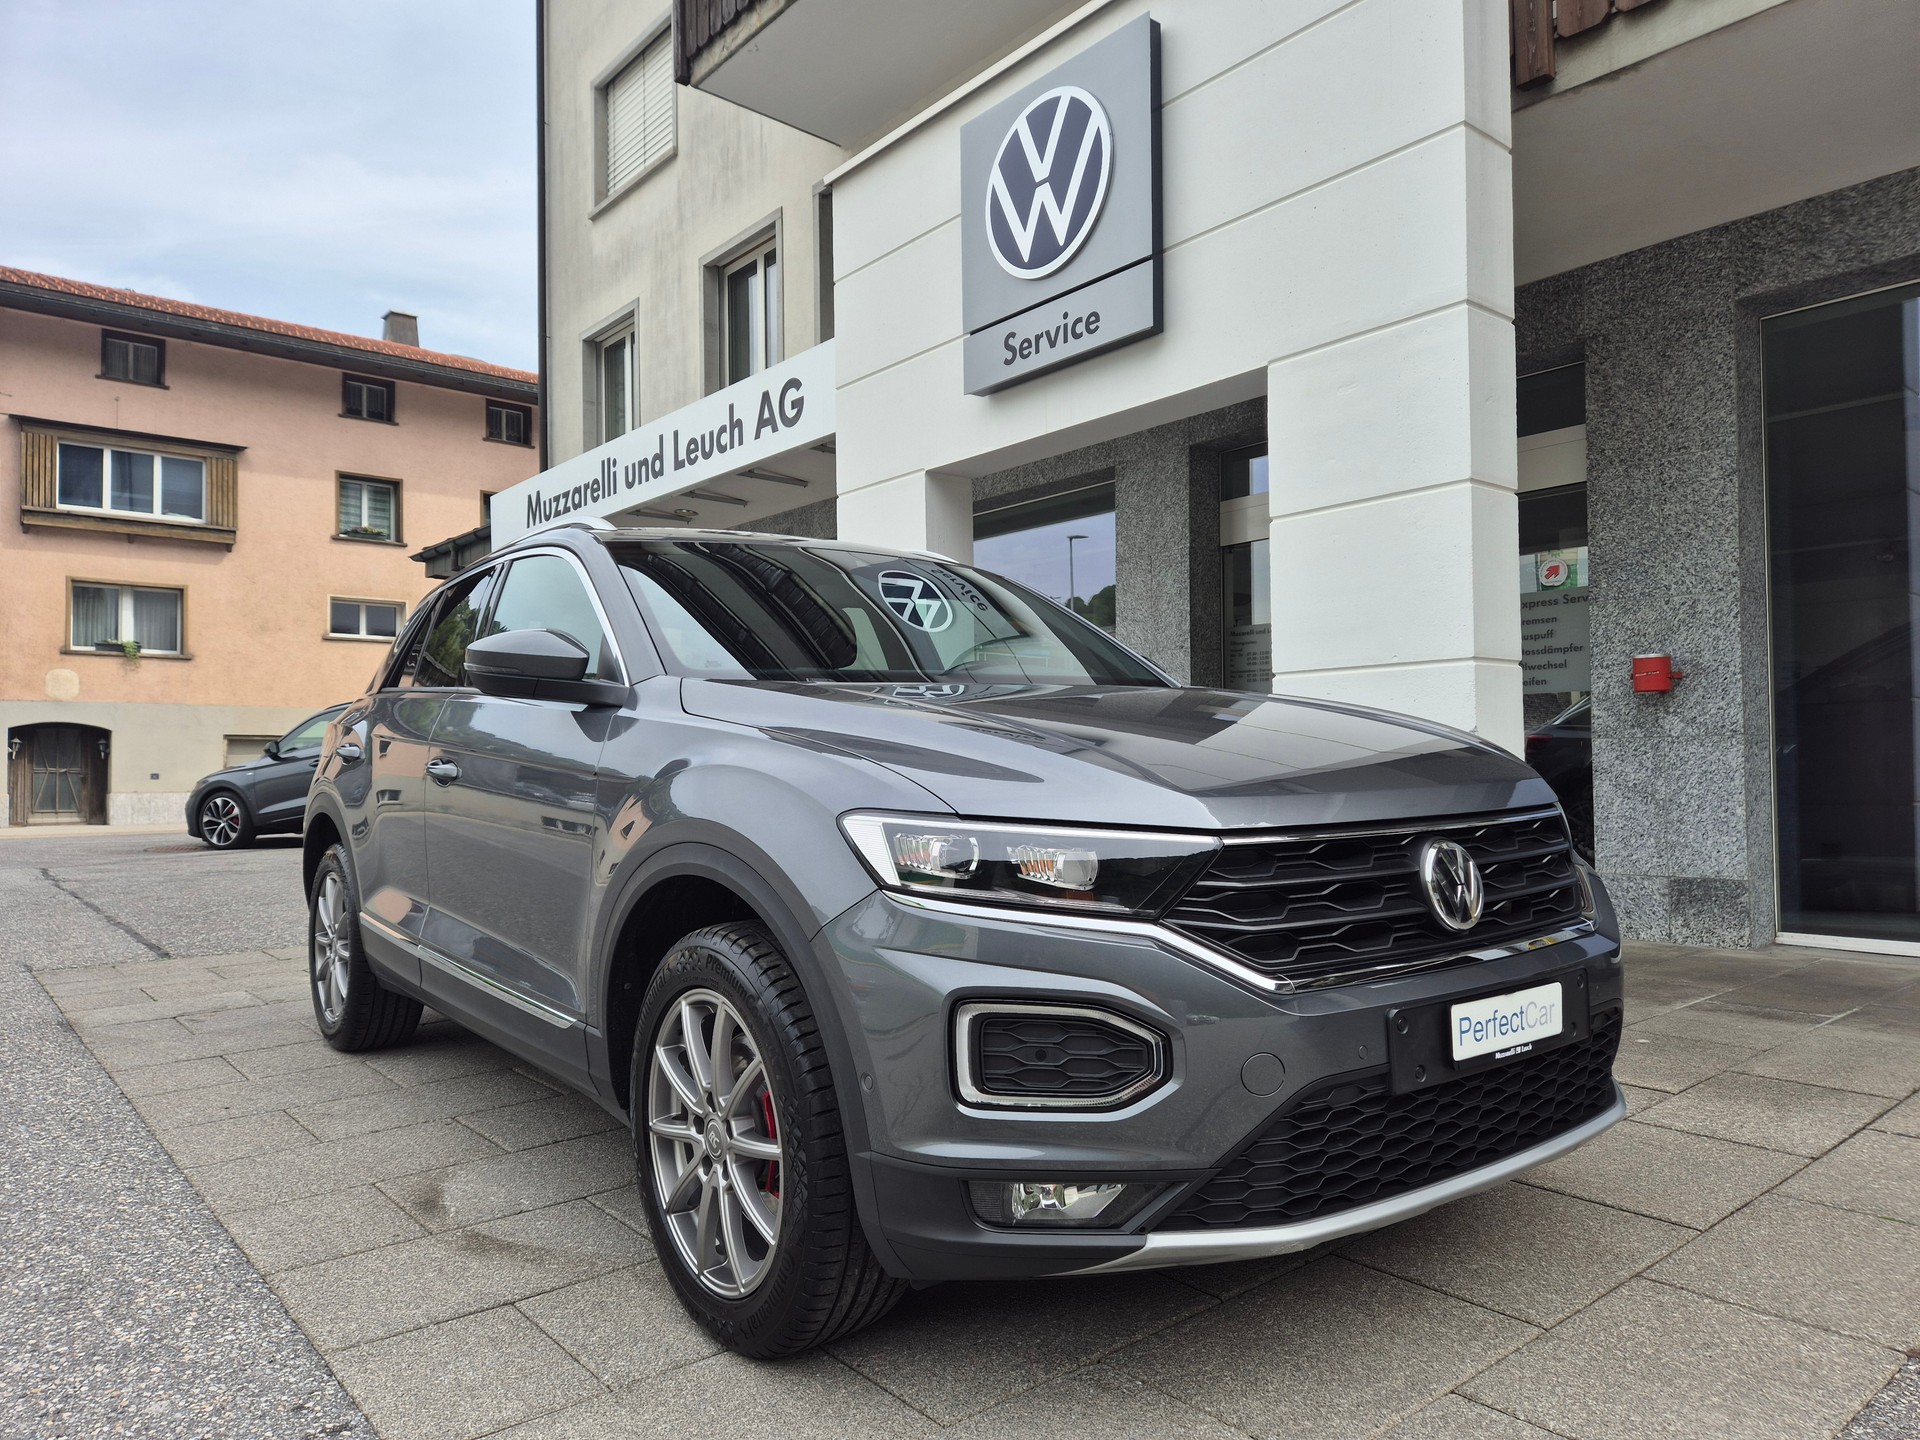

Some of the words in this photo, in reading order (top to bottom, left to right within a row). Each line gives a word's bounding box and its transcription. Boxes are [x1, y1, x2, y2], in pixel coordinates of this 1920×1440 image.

[1003, 311, 1101, 366] Service
[527, 457, 618, 529] Muzzarelli
[624, 434, 664, 490] und
[673, 403, 744, 471] Leuch
[754, 377, 805, 440] AG
[1521, 598, 1559, 610] xpress
[1562, 593, 1589, 605] Serv
[1521, 615, 1557, 626] remsen
[1521, 630, 1555, 643] uspuff
[1521, 643, 1584, 656] tossdämpfer
[1523, 677, 1547, 687] eifen
[1459, 1001, 1556, 1046] PerfectCar
